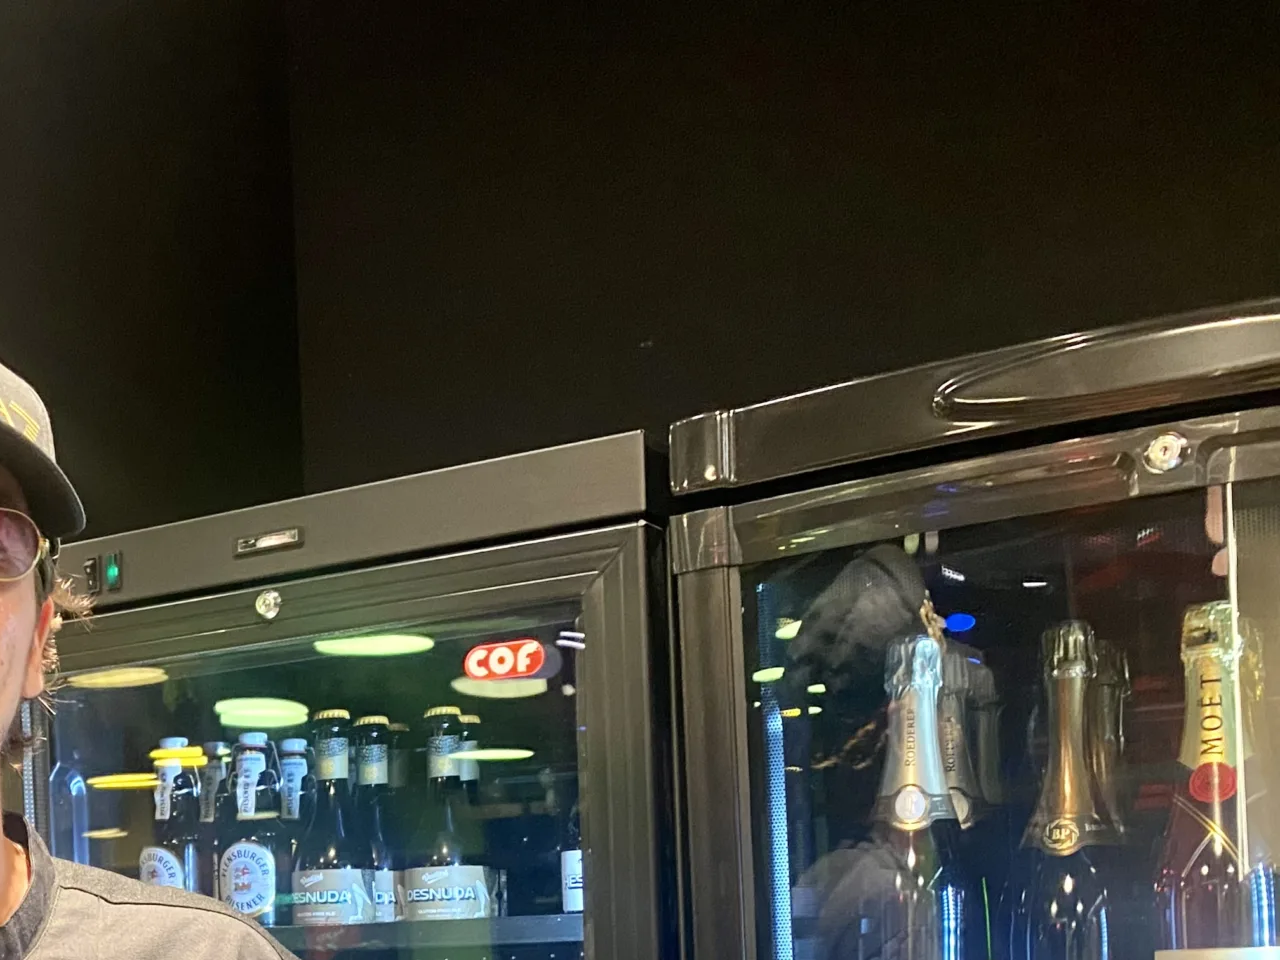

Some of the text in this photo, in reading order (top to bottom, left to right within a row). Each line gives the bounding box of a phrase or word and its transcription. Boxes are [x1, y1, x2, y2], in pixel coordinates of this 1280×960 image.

[468, 641, 540, 677] COF
[221, 848, 269, 878] FLENSBURGER
[407, 887, 475, 901] DESNUDA
